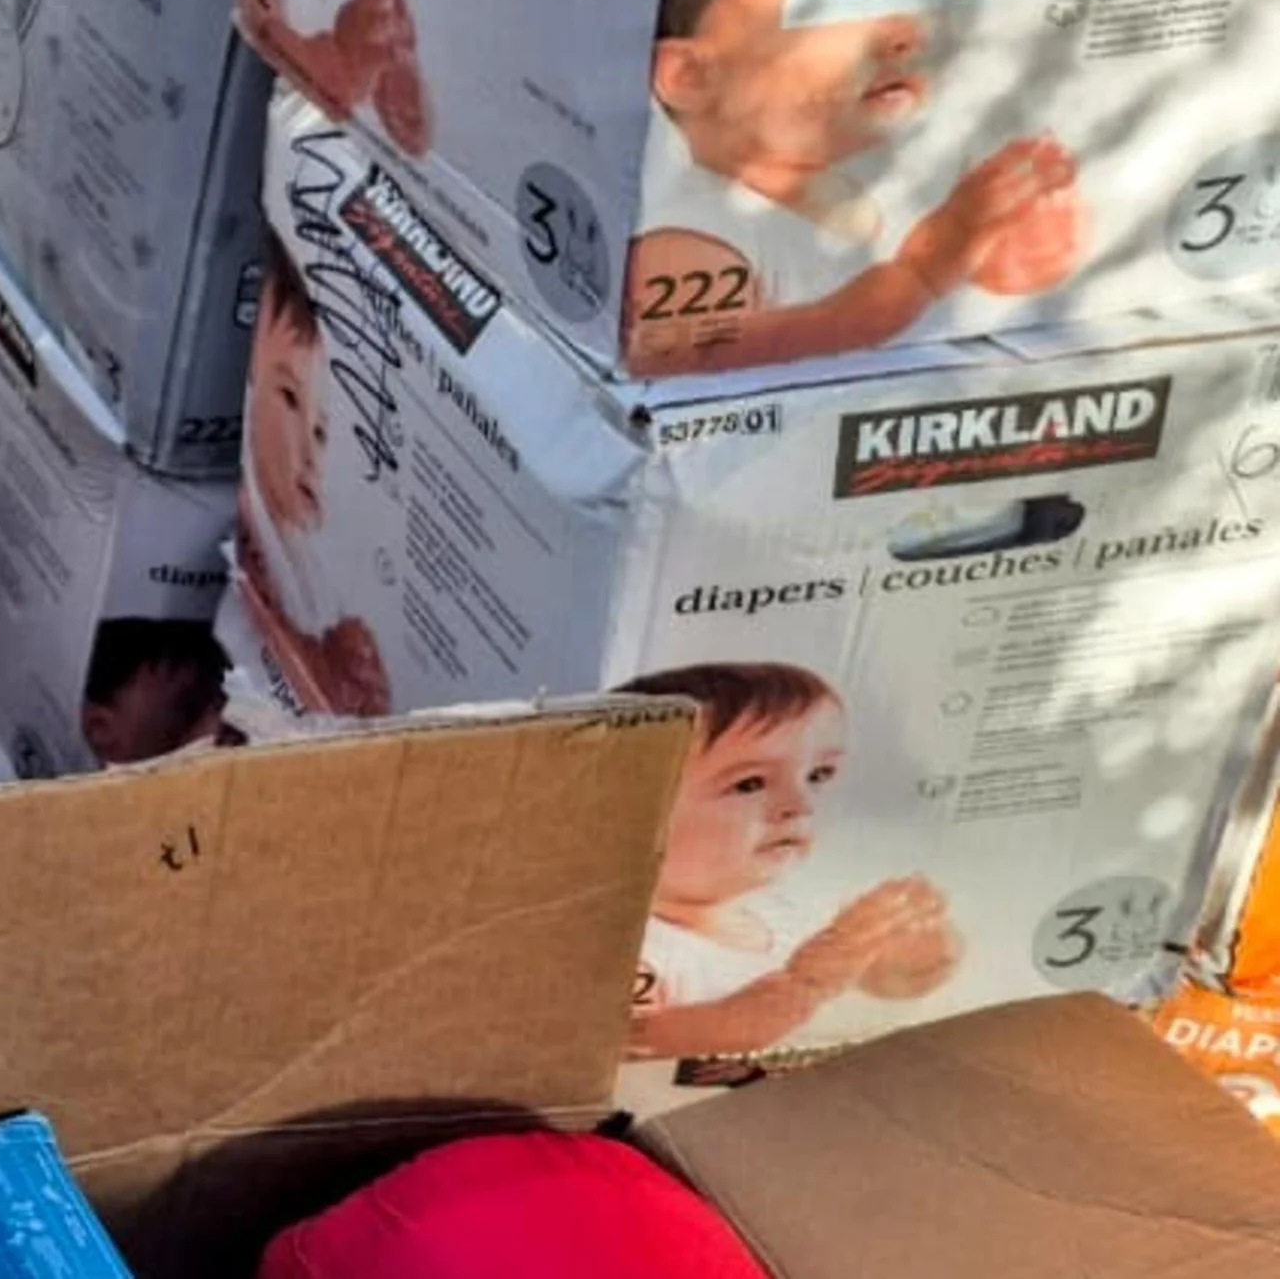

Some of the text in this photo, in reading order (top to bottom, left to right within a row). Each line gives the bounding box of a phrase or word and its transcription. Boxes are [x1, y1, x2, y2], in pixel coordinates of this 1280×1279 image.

[1179, 173, 1247, 254] 3
[641, 266, 751, 321] 222
[855, 388, 1156, 463] KIRKLAND
[673, 573, 847, 618] diapers
[881, 547, 1062, 594] couches
[1045, 906, 1104, 968] 3
